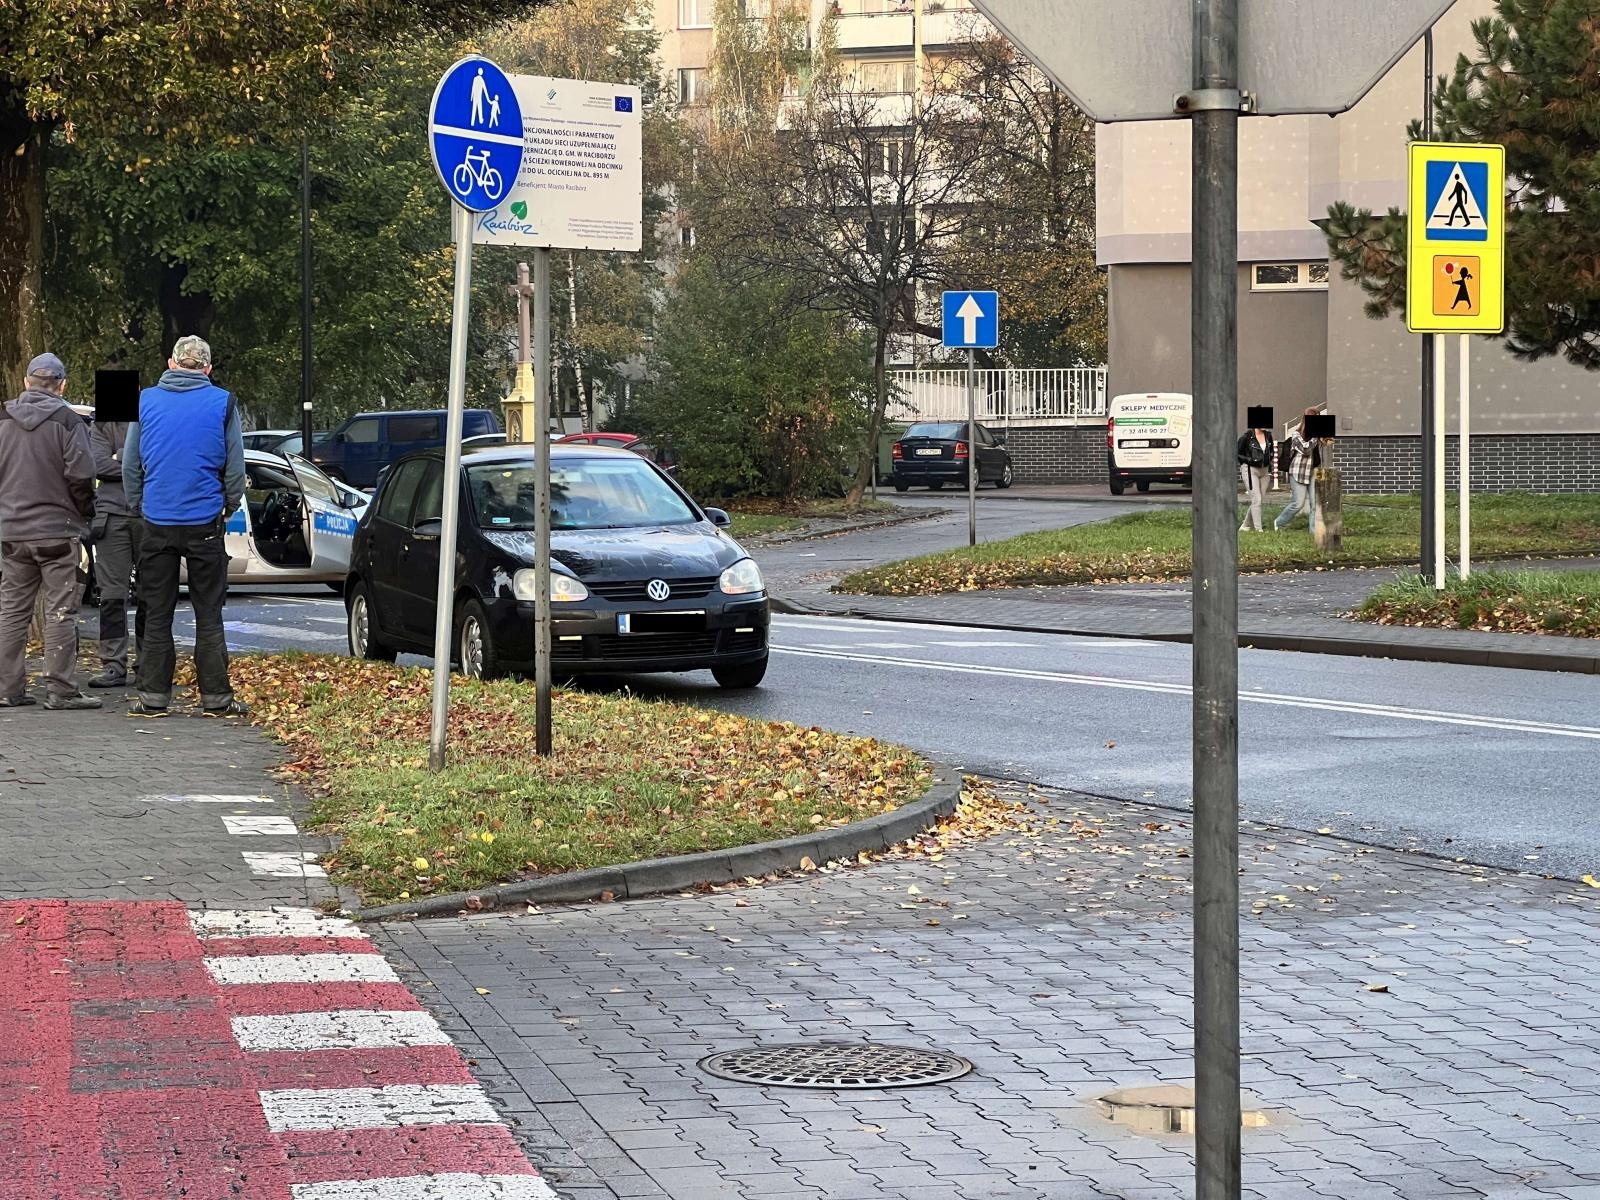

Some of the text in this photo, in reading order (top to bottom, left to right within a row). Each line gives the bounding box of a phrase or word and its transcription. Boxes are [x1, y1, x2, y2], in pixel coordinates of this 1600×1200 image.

[569, 141, 616, 151] UZUPEŁNIAJĄCEJ
[551, 158, 587, 167] ROWEROWEJ
[548, 169, 573, 177] OCICKIEJ
[326, 514, 349, 531] POLICJA
